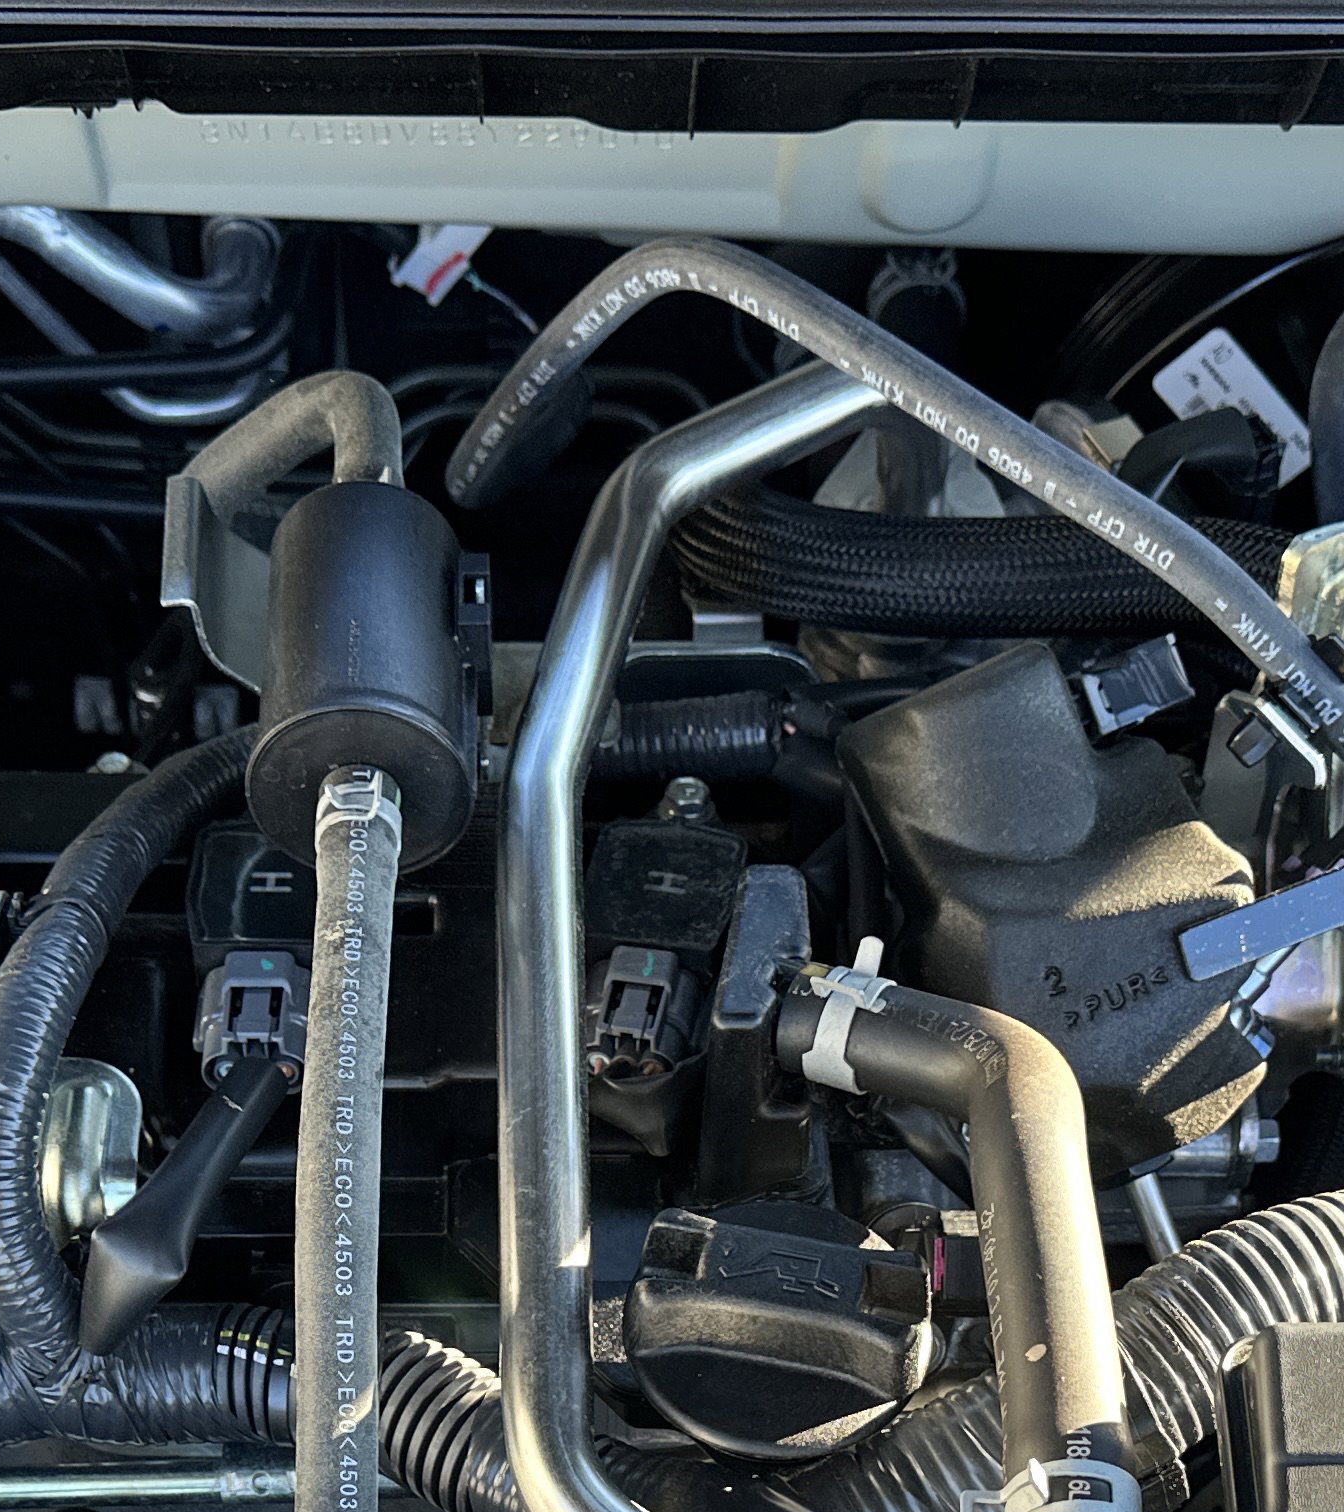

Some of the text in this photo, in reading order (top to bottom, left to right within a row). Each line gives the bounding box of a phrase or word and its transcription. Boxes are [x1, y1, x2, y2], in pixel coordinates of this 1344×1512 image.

[861, 365, 904, 405] KINK
[915, 400, 947, 432] NOT
[956, 426, 980, 454] DO
[988, 447, 1033, 485] 4806
[1133, 535, 1176, 572] DTR
[1232, 612, 1281, 662] KINK
[1279, 663, 1316, 698] NOT
[249, 872, 293, 893] H
[643, 870, 689, 895] H
[1043, 965, 1066, 997] 2
